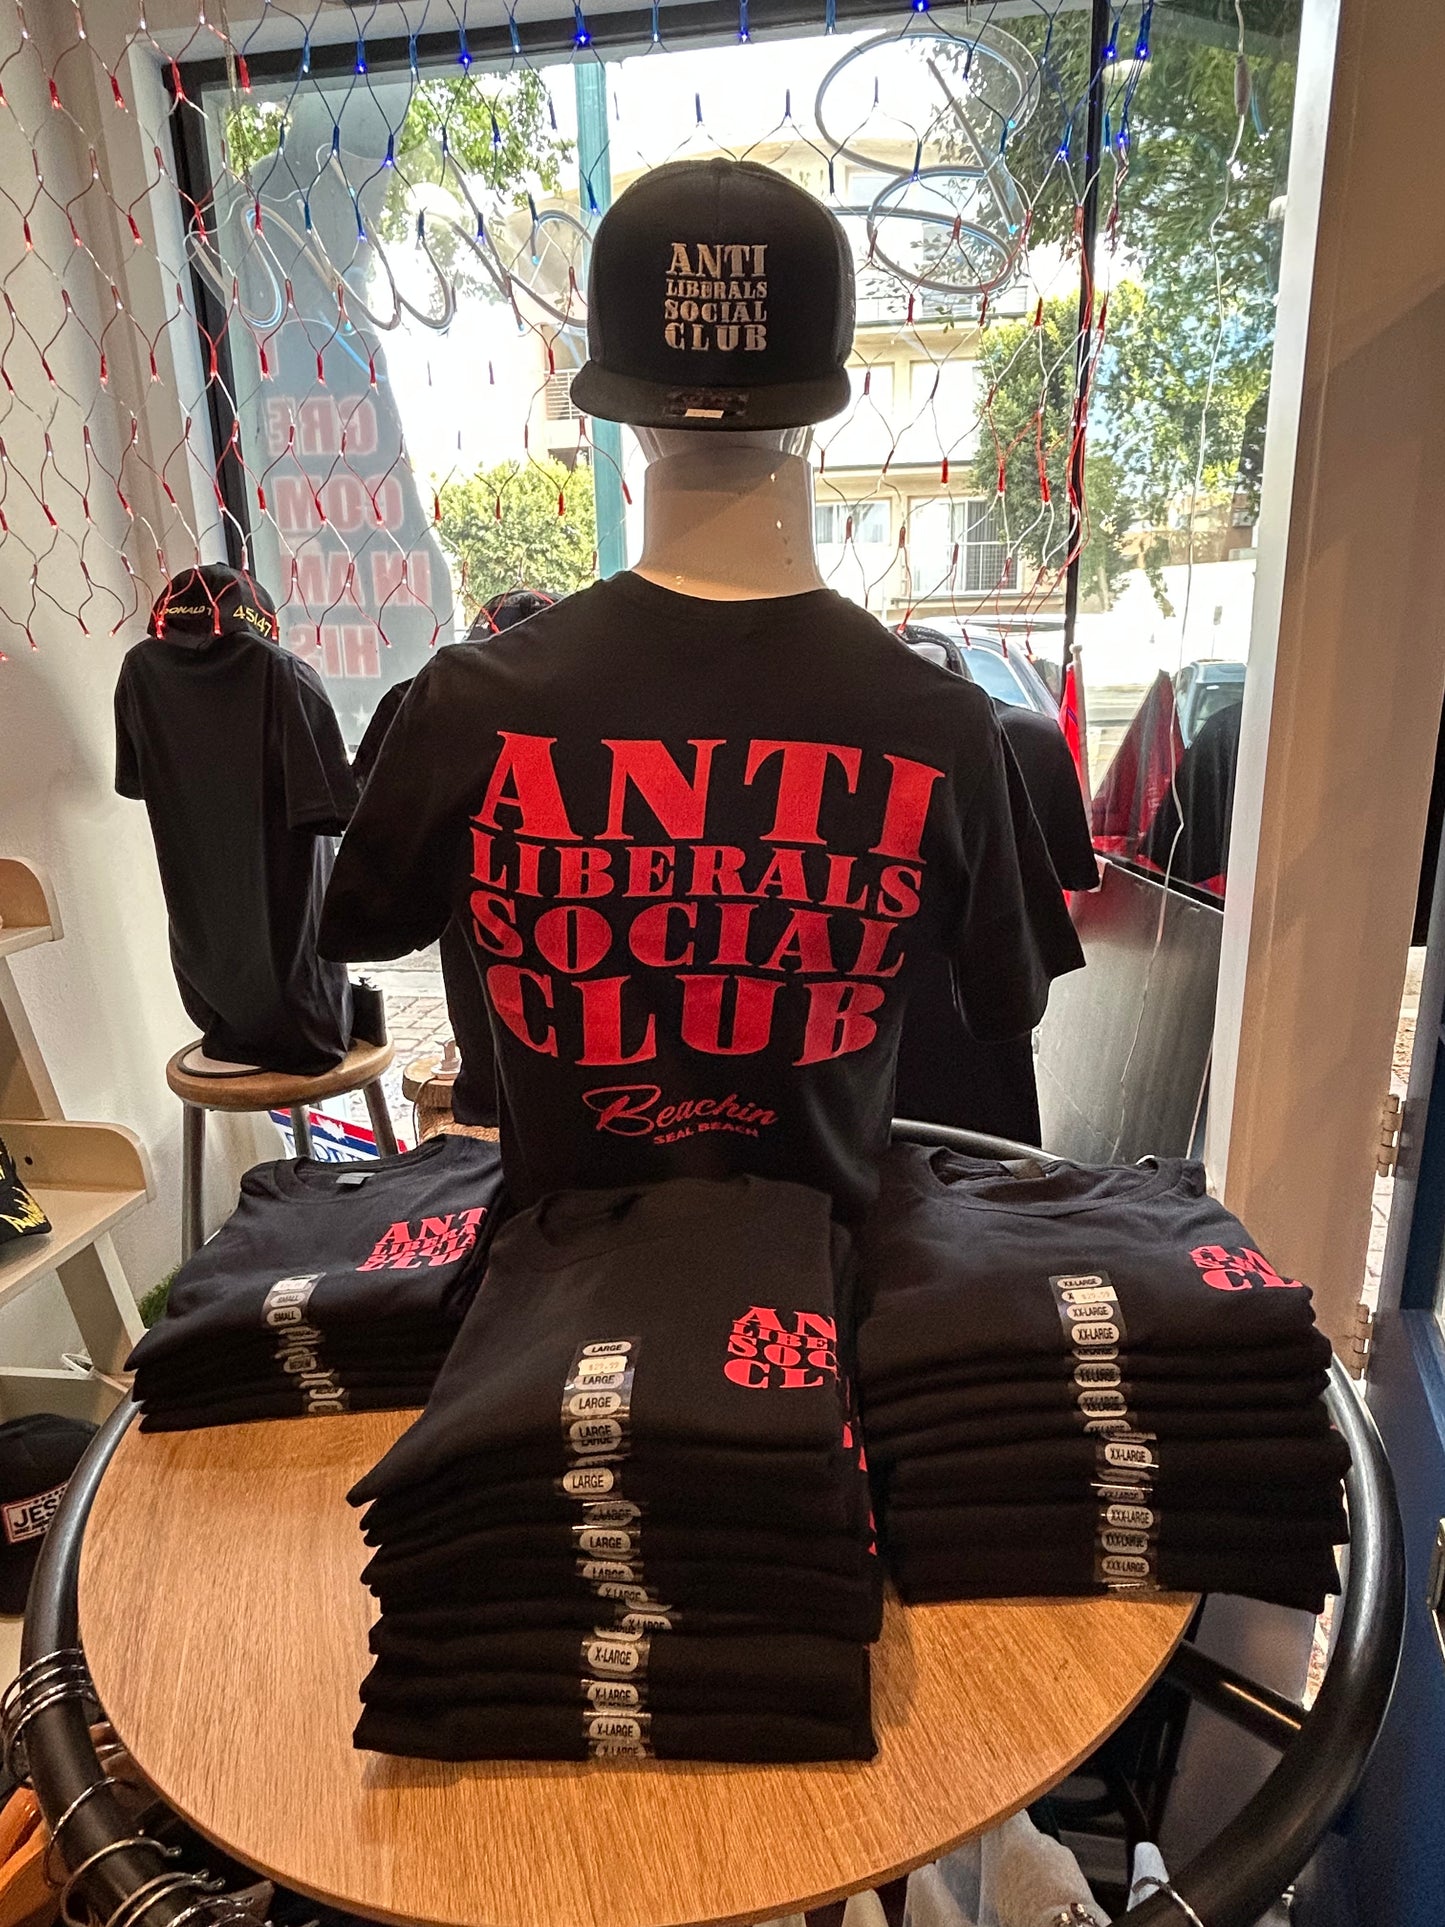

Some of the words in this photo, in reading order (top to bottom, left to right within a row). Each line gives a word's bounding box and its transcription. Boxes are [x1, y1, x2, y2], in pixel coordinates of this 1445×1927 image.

[666, 242, 769, 278] ANTI
[665, 278, 768, 300] LIBERALS
[664, 299, 768, 323] SOCIAL
[664, 322, 768, 351] CLUB
[469, 731, 946, 864] ANTI
[469, 826, 923, 918] LIBERALS
[469, 890, 905, 979] SOCIAL
[486, 964, 886, 1067] CLUB
[582, 1084, 778, 1136] Beachin
[653, 1127, 694, 1145] SEAL
[697, 1121, 760, 1138] BEACH
[1064, 1278, 1098, 1287] XX-LARGE
[273, 1310, 296, 1323] SMALL
[1072, 1306, 1109, 1317] XX-LARGE
[1077, 1327, 1114, 1341] XX-LARGE
[591, 1343, 623, 1353] LARGE
[582, 1375, 615, 1385] LARGE
[579, 1396, 612, 1410] LARGE
[579, 1425, 611, 1438] LARGE
[1110, 1448, 1146, 1462] XX-LARGE
[572, 1475, 604, 1489] LARGE
[1111, 1508, 1150, 1524] XXX-LARGE
[589, 1536, 622, 1549] LARGE
[1106, 1559, 1146, 1573] XXX-LARGE
[595, 1650, 632, 1666] X-LARGE
[597, 1723, 633, 1737] X-LARGE
